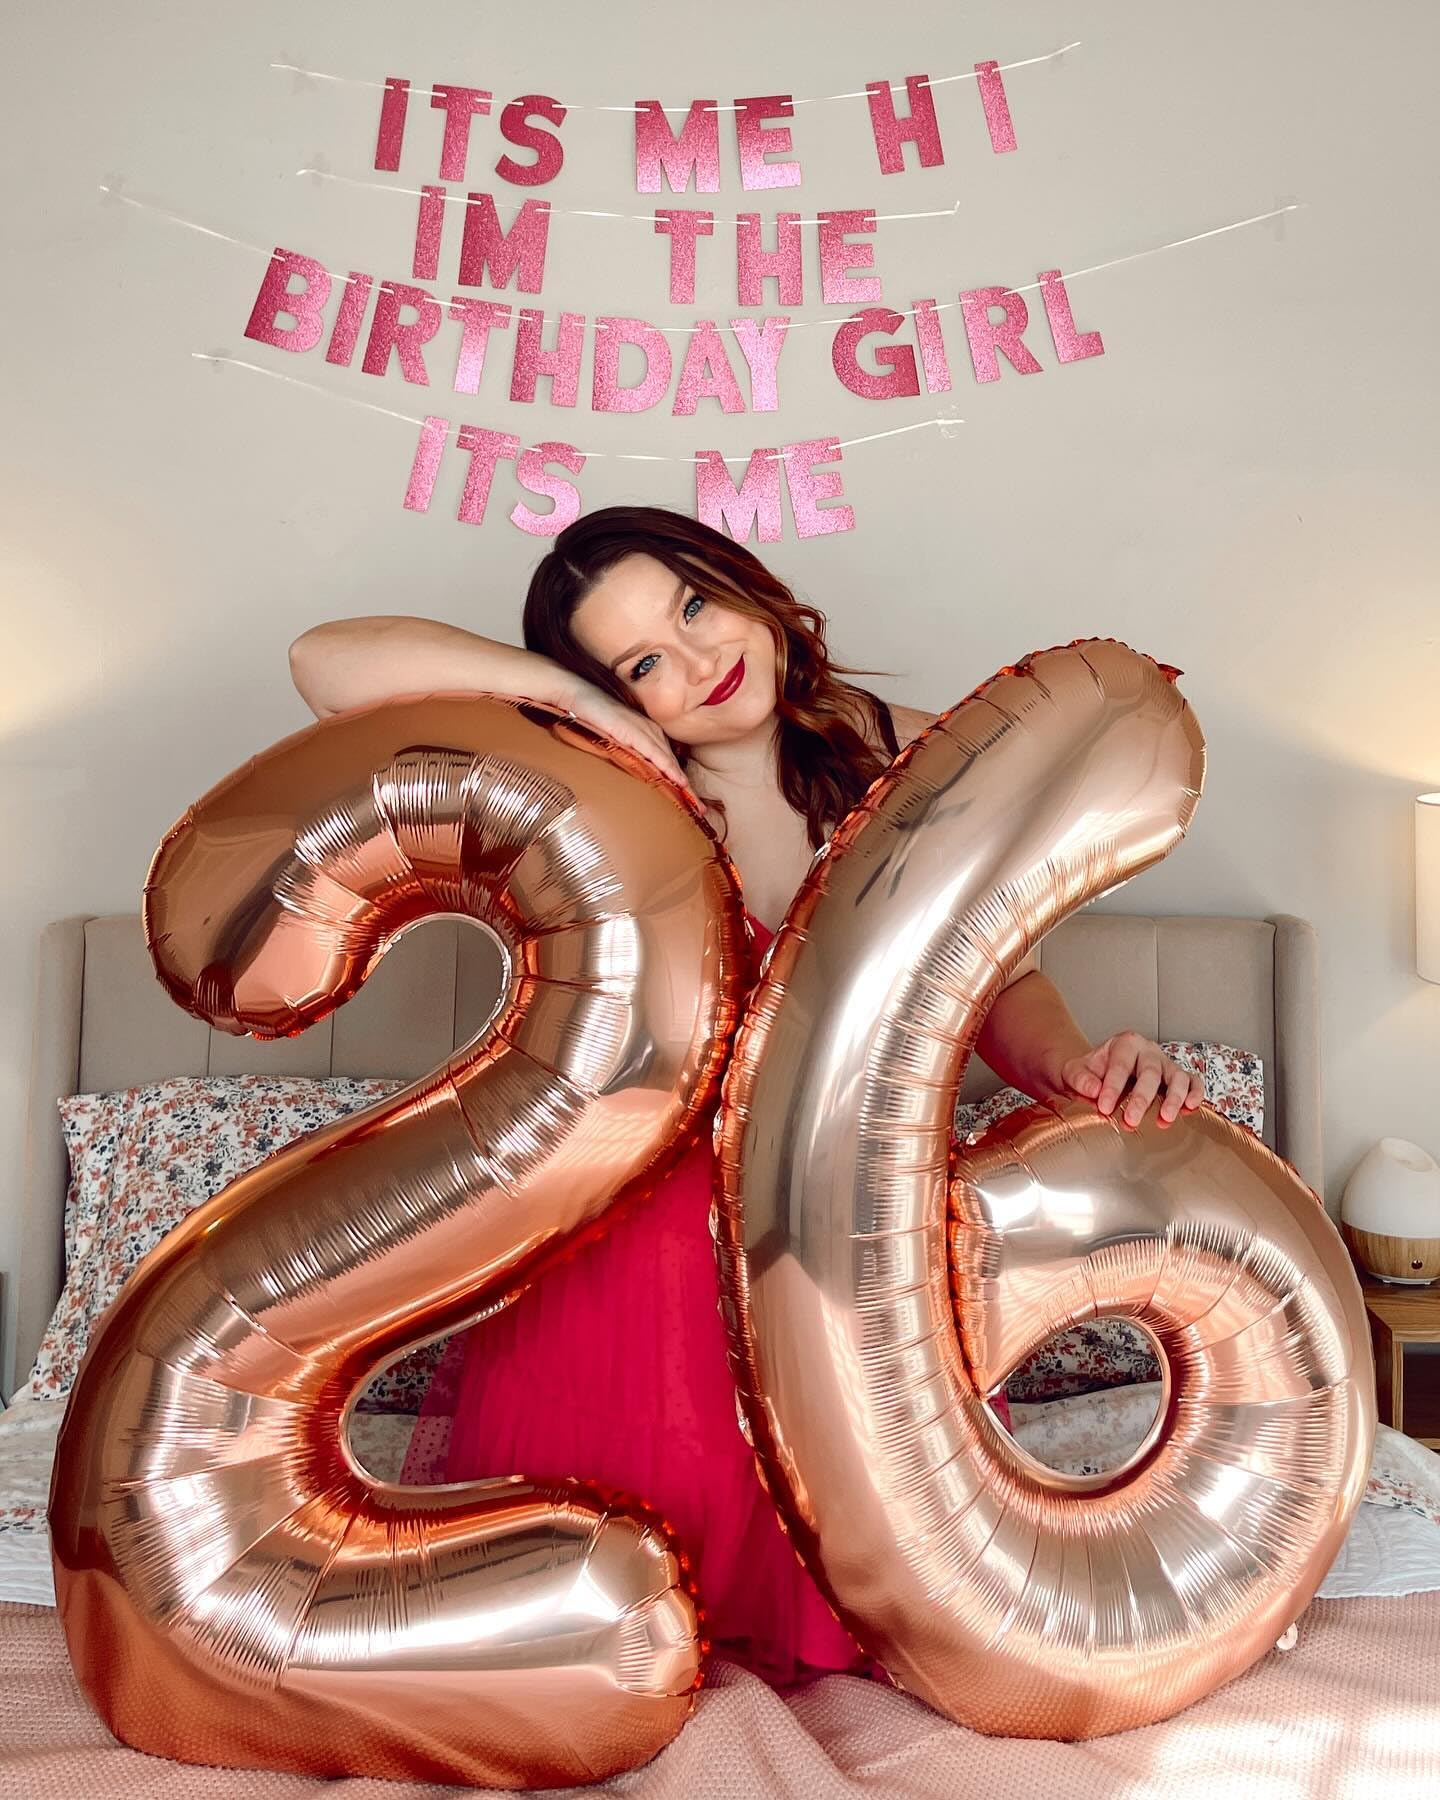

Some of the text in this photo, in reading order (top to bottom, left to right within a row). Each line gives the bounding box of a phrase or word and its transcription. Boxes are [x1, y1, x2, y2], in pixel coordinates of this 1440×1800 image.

[374, 77, 568, 187] ITS
[634, 95, 803, 194] ME
[412, 185, 883, 307] IM THE
[243, 247, 1104, 416] BIRTHDAY GIRL
[402, 415, 857, 544] ITS ME
